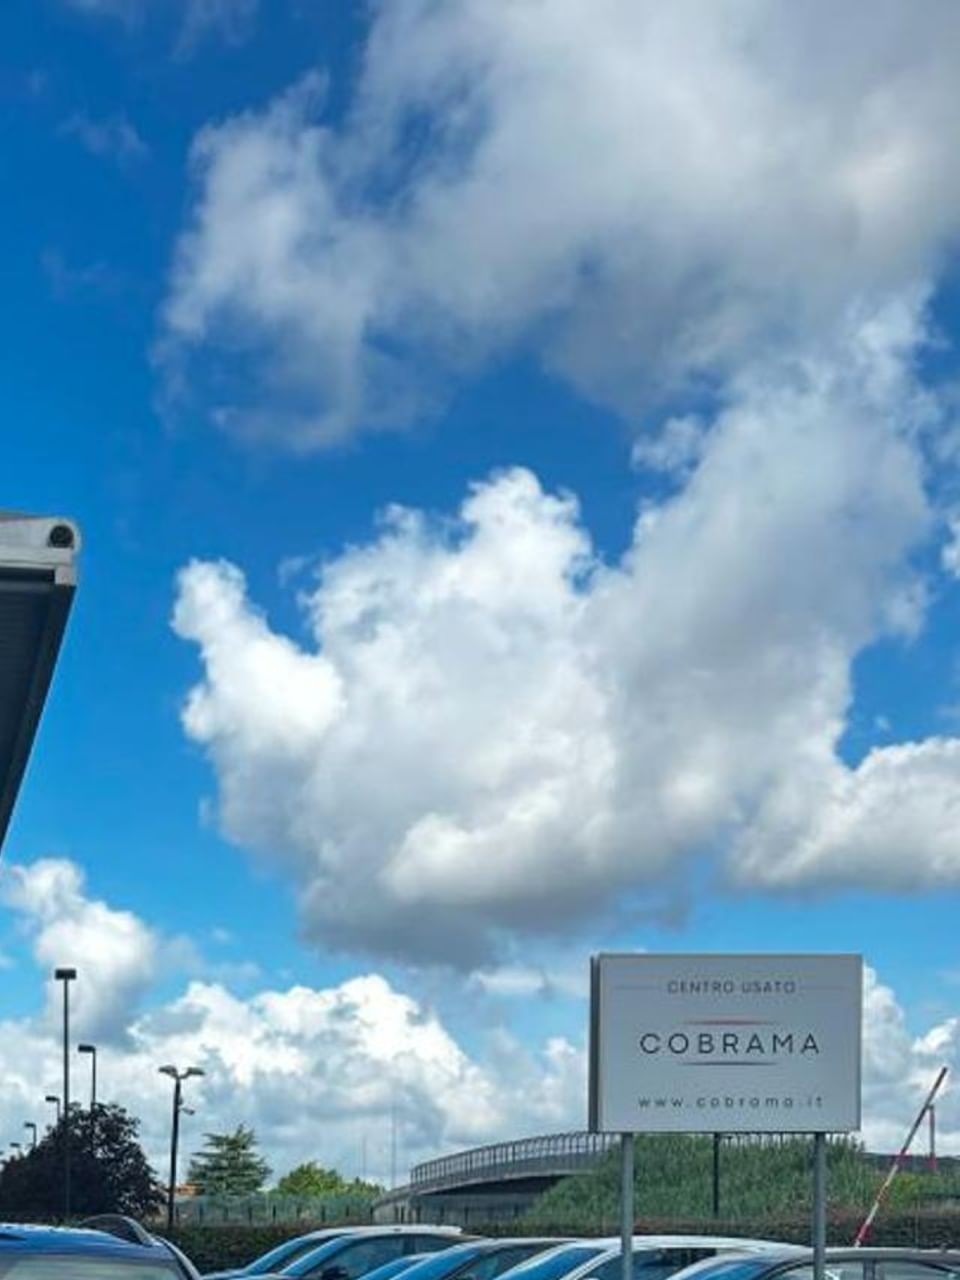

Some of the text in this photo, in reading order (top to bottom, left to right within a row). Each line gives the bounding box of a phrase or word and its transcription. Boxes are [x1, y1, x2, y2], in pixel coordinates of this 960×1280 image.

[667, 980, 796, 993] CENTRO USATO
[640, 1033, 820, 1054] COBRAMA
[638, 1095, 823, 1109] www.cobrama.it
